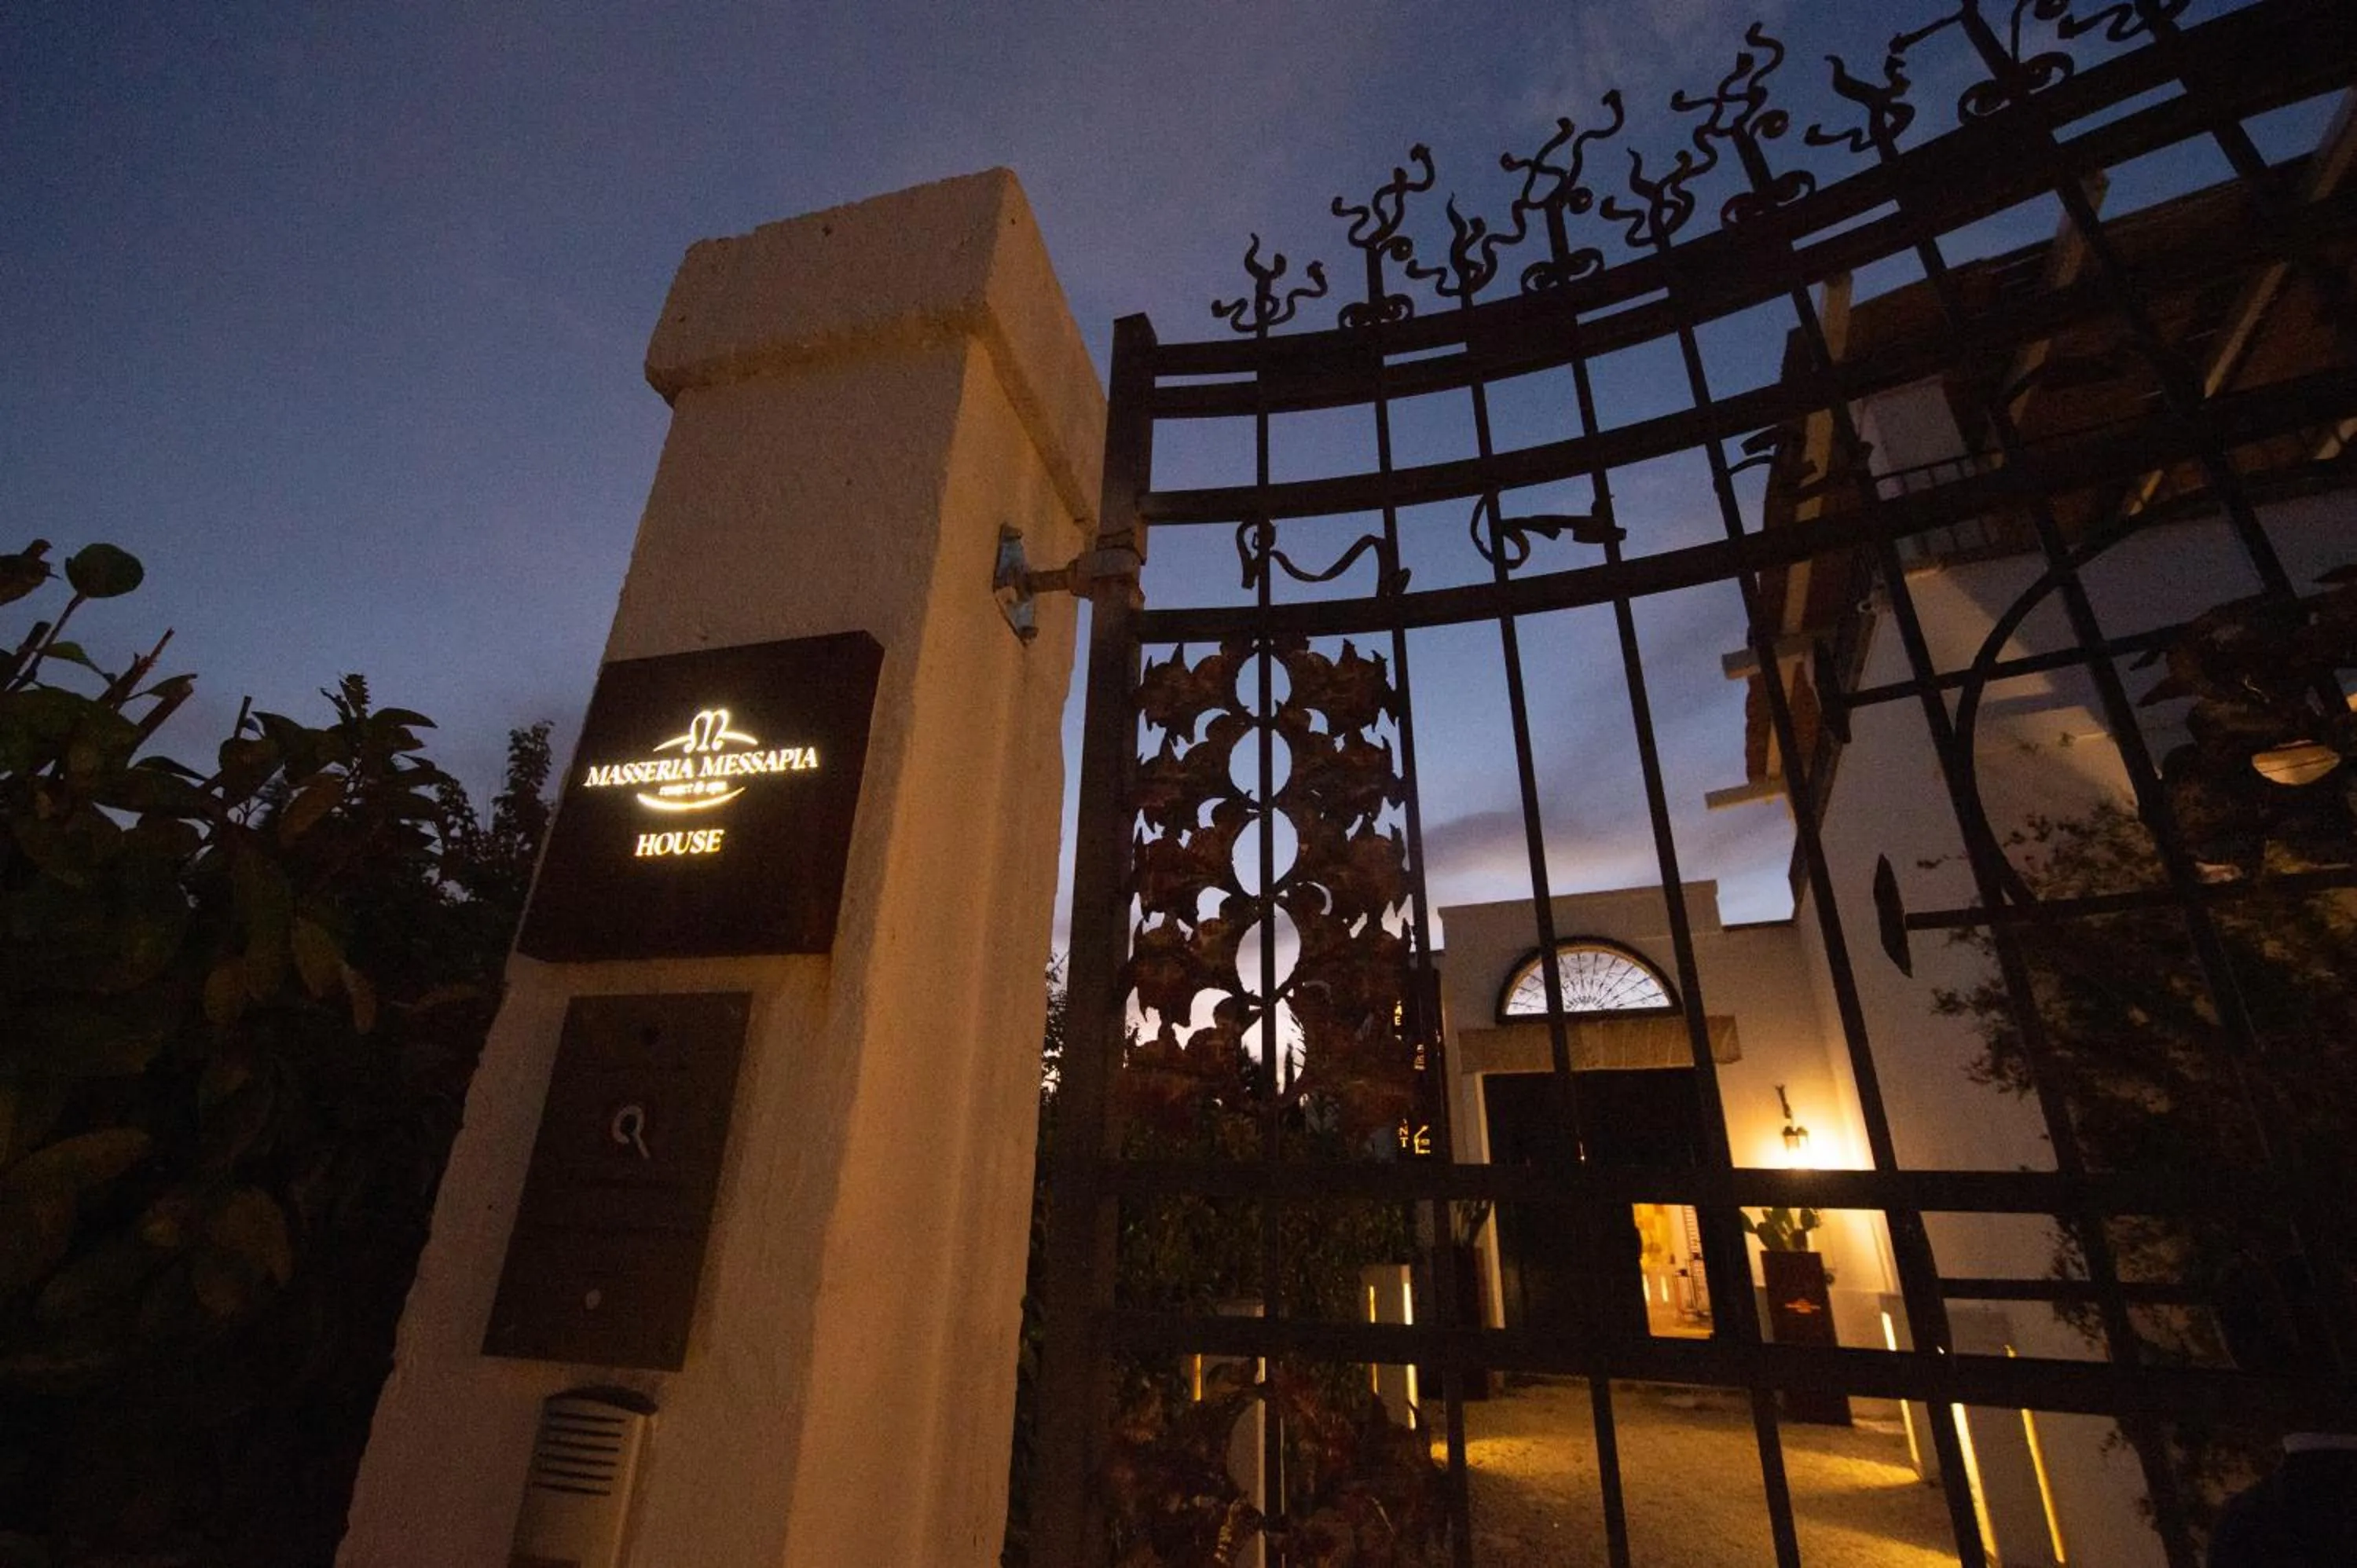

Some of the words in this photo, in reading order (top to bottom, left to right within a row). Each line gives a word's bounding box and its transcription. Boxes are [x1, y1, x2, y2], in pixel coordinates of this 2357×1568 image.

[584, 757, 693, 788] MASSERIA
[699, 746, 818, 778] MESSAPIA
[634, 829, 724, 857] HOUSE
